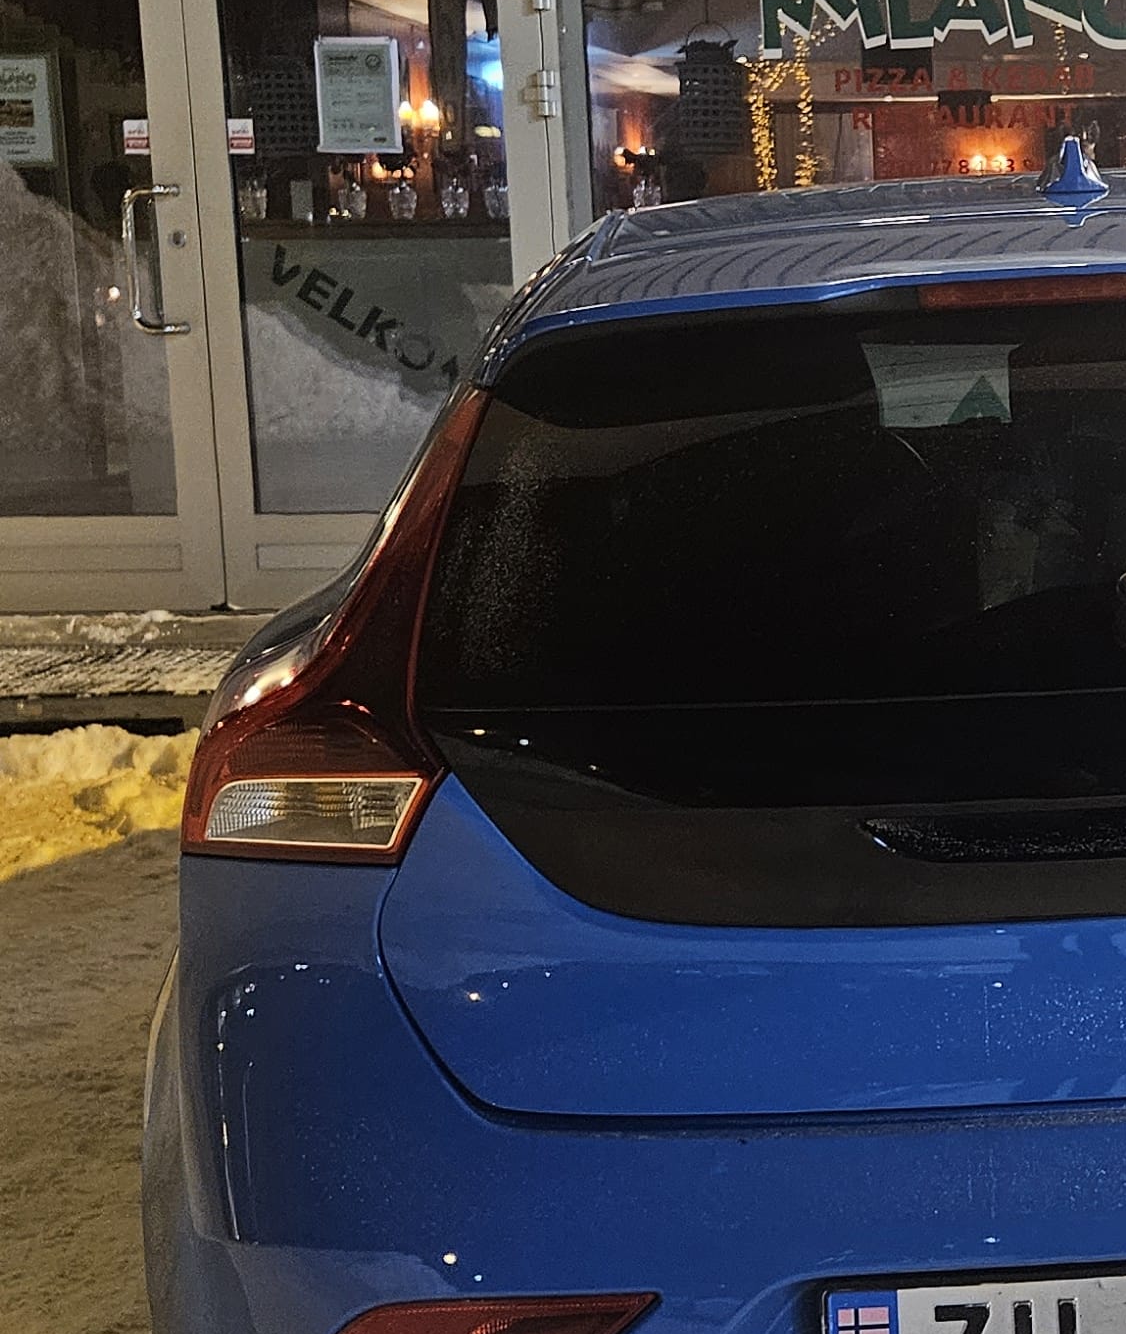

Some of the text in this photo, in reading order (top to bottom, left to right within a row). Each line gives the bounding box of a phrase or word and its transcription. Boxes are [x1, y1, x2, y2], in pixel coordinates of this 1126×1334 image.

[834, 67, 933, 92] PIZZA
[981, 63, 1095, 92] KEBAB
[852, 102, 1079, 131] RAURANT
[271, 243, 460, 387] VELKO
